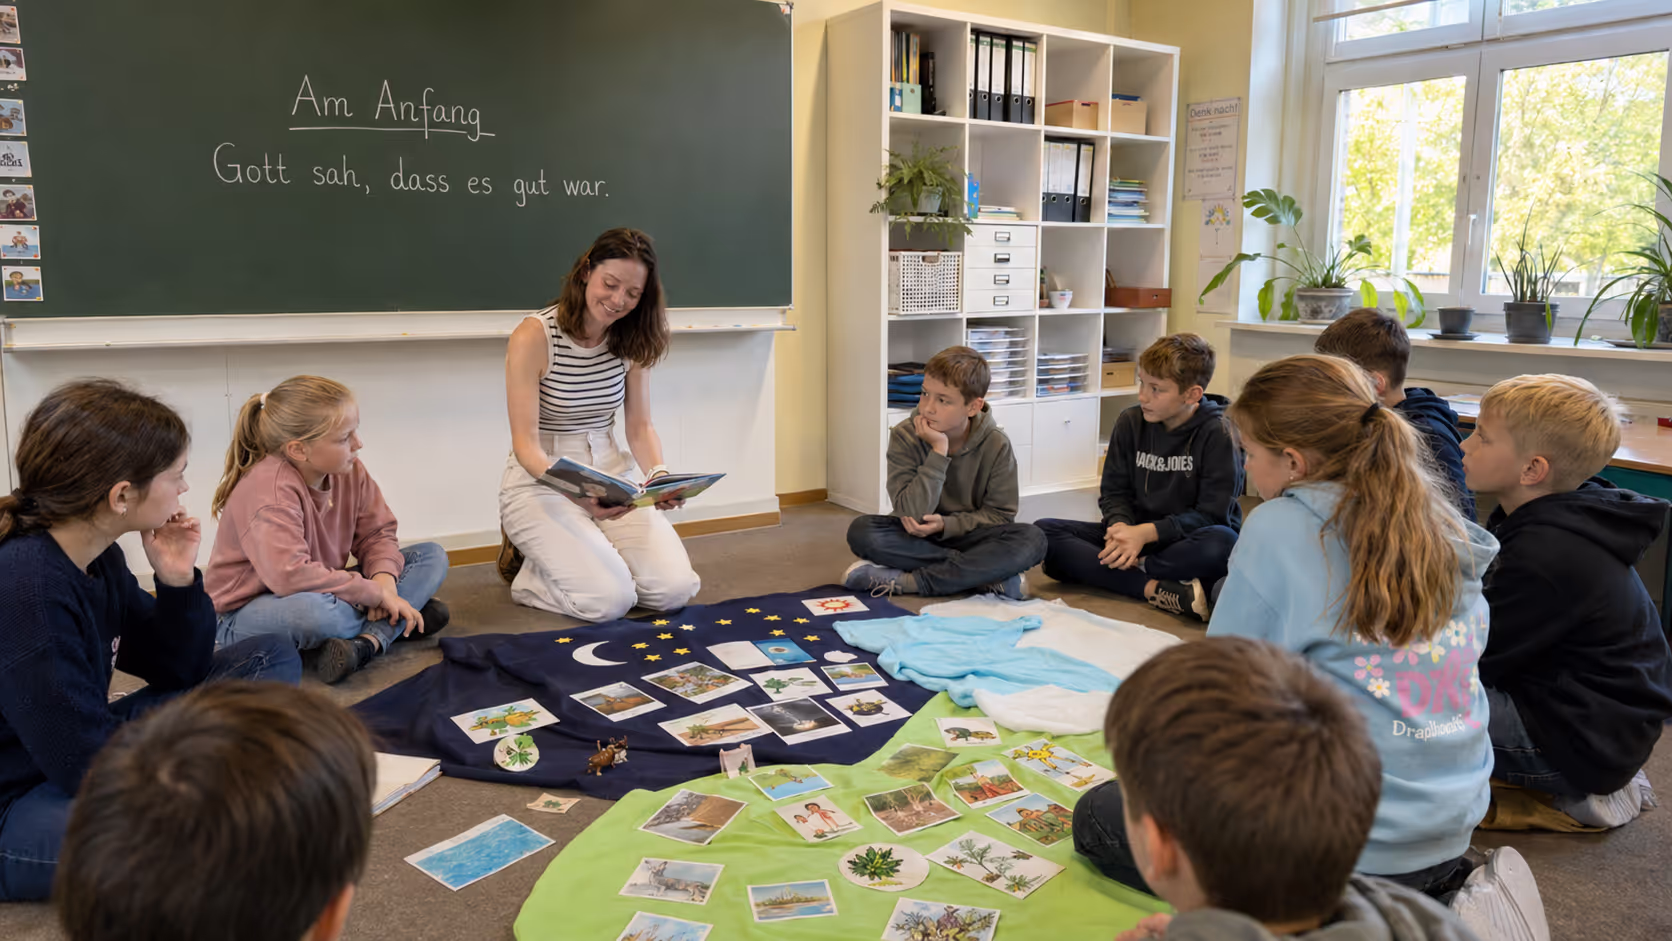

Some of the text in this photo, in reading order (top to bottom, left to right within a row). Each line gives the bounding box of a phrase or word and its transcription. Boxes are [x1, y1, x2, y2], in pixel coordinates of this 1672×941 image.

[291, 74, 481, 142] Am Anfang
[1190, 102, 1238, 118] Denk nach!
[213, 142, 610, 207] Gott sah, dass es gut war.
